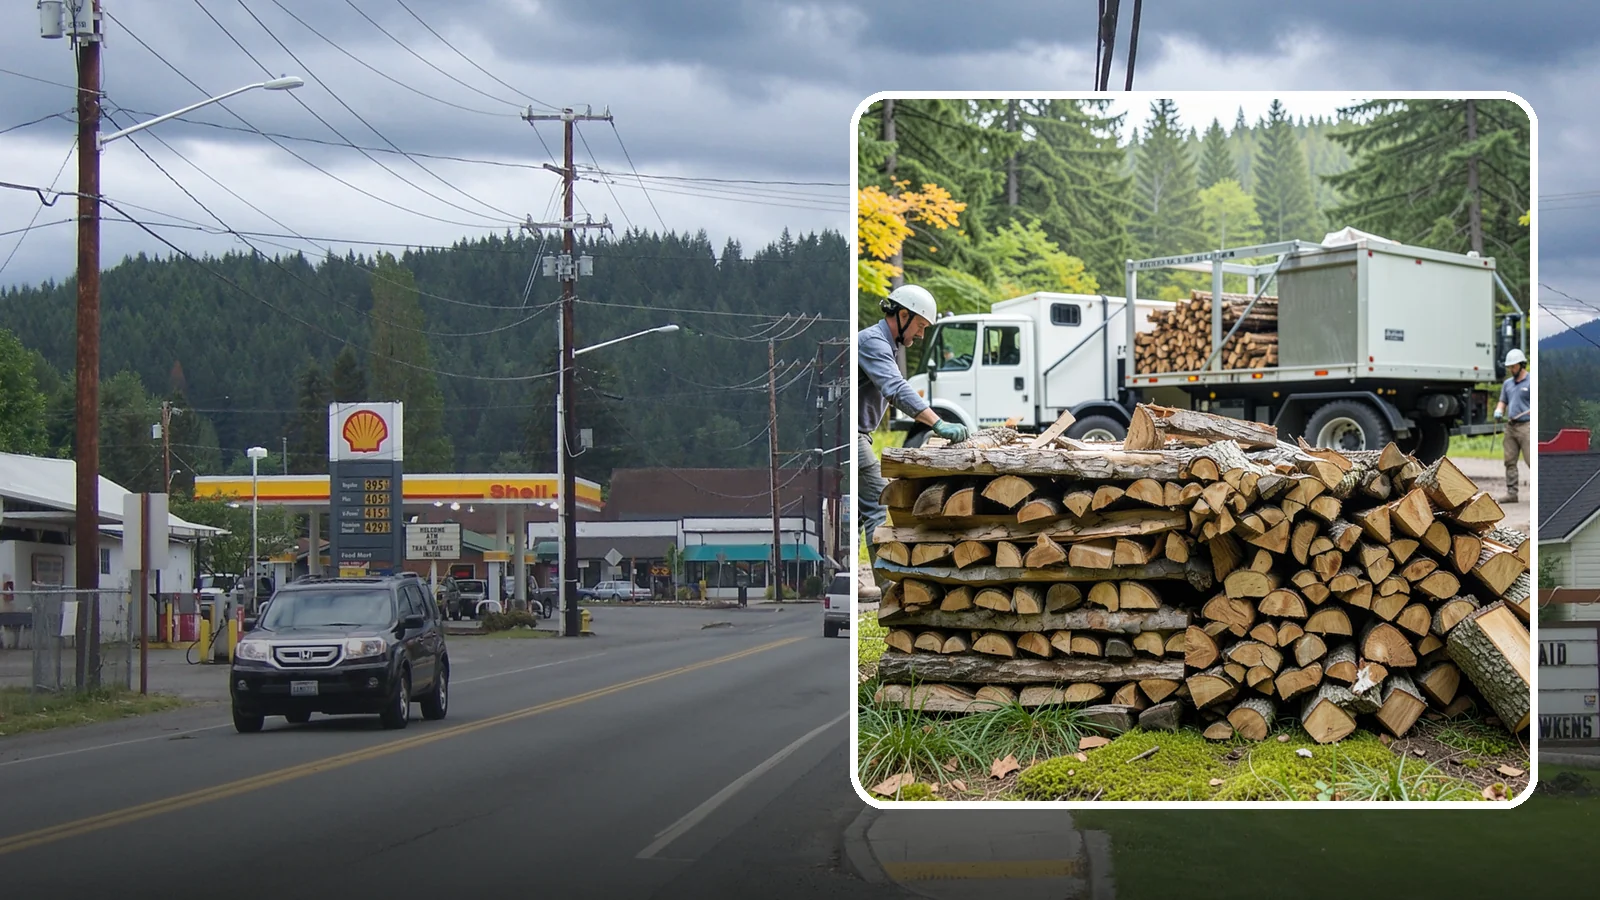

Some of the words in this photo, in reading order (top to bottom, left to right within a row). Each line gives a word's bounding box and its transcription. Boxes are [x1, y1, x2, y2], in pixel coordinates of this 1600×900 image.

[366, 480, 383, 490] 395
[490, 484, 547, 499] Shell
[366, 494, 383, 504] 405
[366, 508, 383, 518] 415
[366, 522, 383, 533] 429
